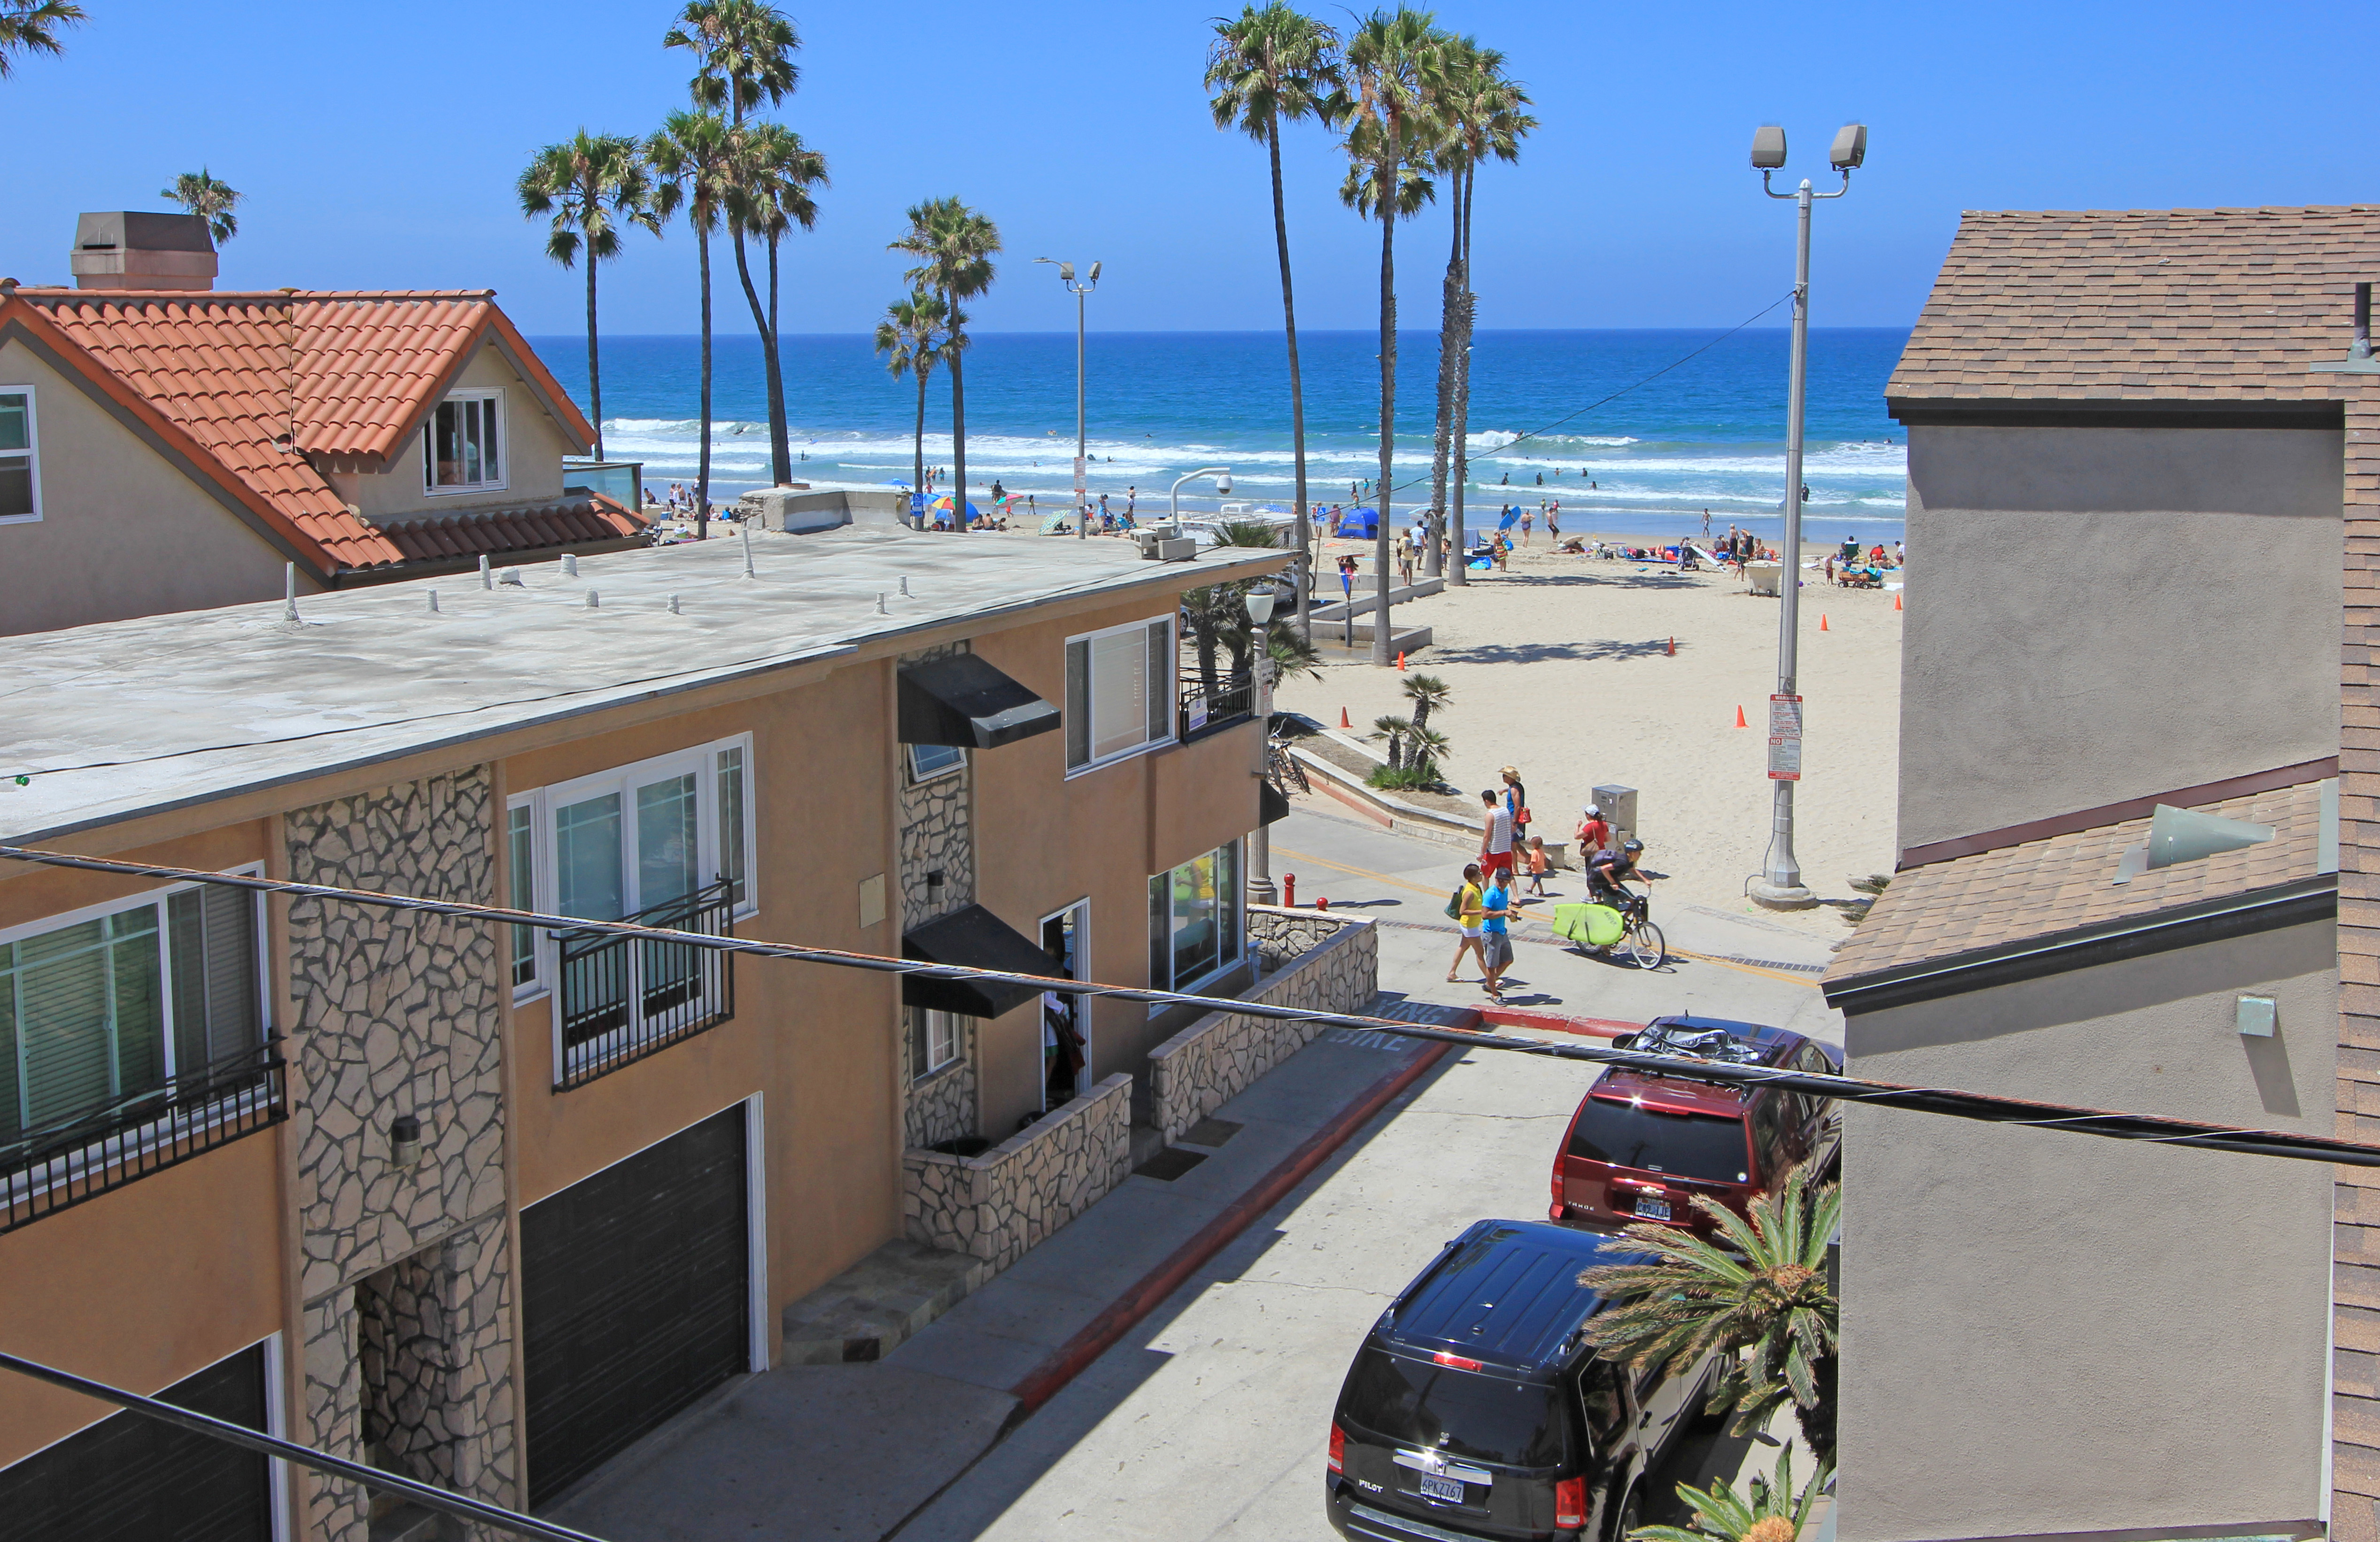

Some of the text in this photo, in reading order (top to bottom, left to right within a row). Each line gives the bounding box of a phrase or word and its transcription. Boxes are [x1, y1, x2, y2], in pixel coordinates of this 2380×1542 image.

[1568, 1201, 1594, 1211] TAHOE
[1359, 1479, 1383, 1493] PILOT
[1422, 1479, 1462, 1499] 6PKZ767
[1420, 1490, 1462, 1503] HONDA WORLD
